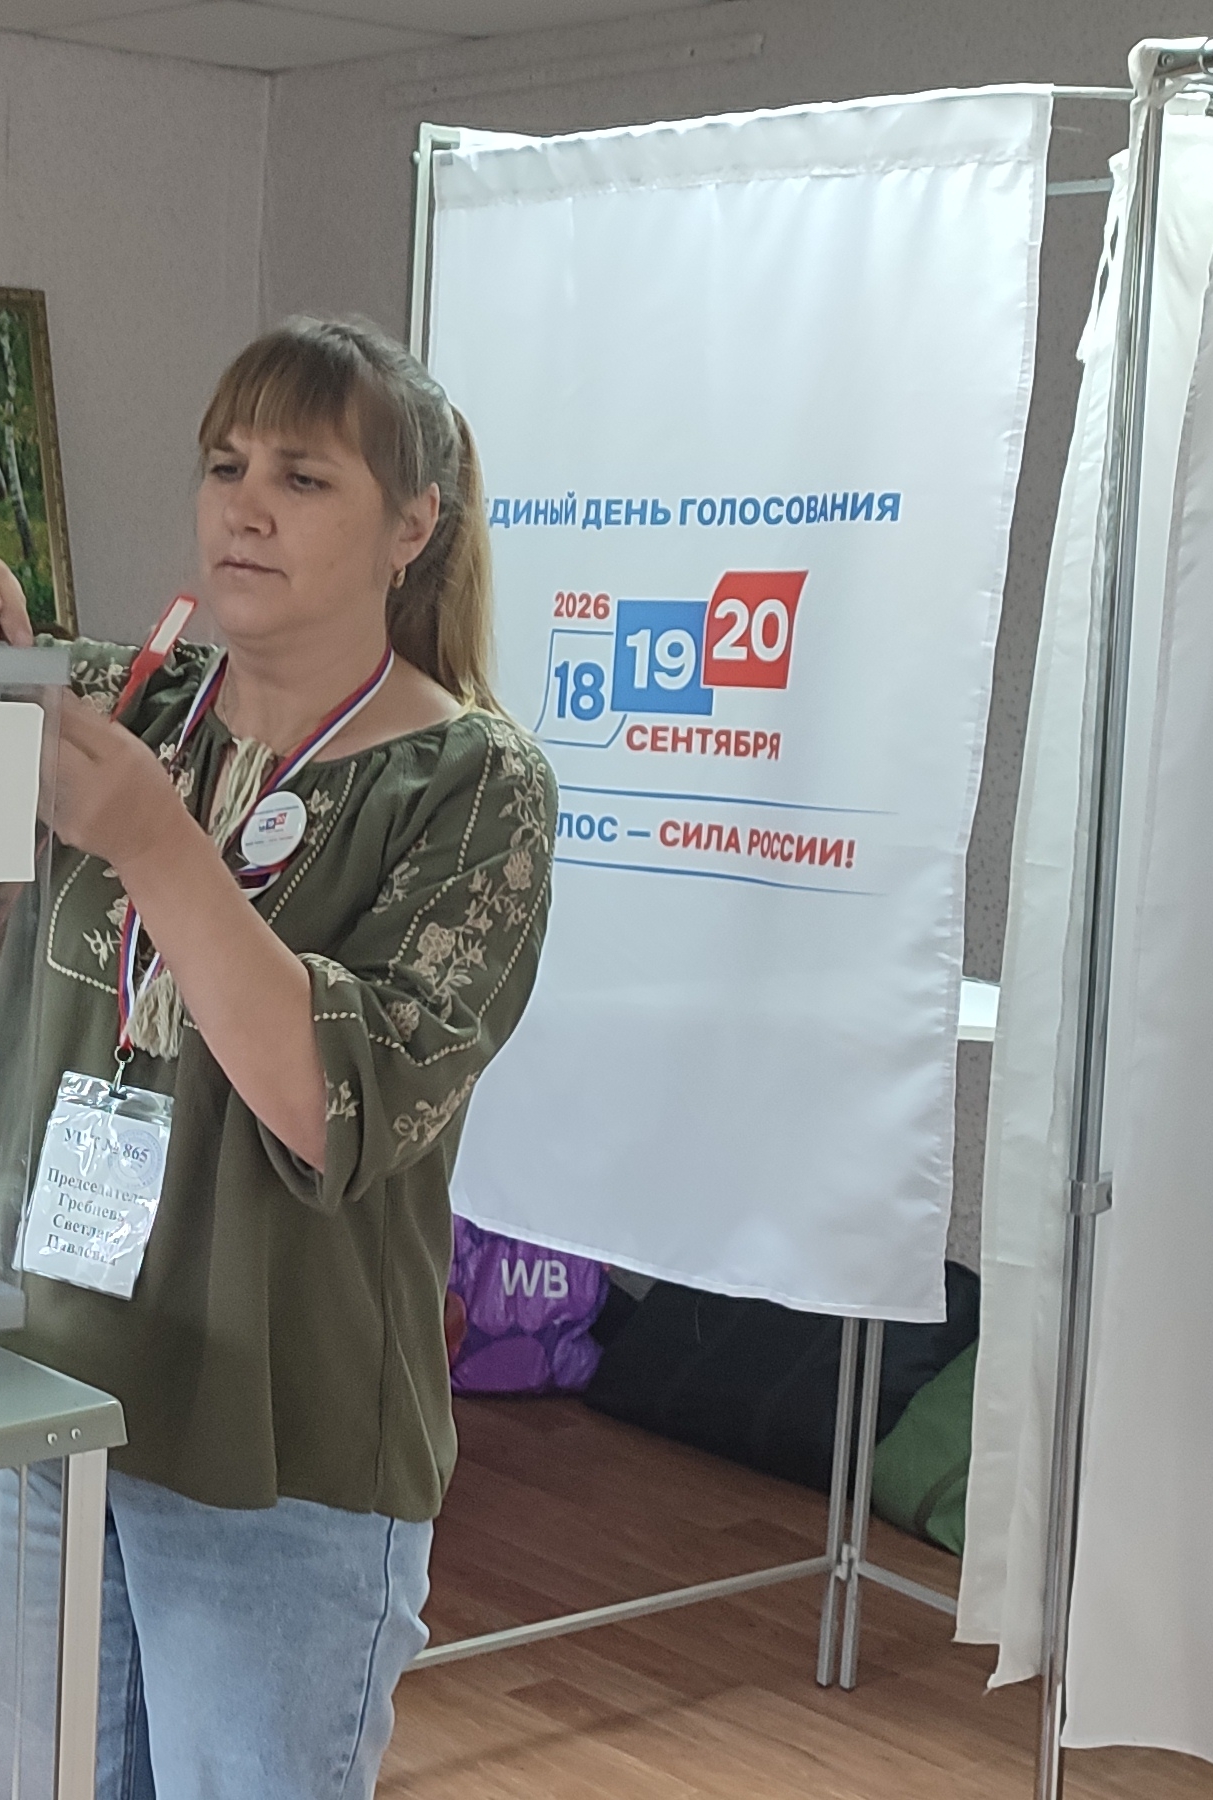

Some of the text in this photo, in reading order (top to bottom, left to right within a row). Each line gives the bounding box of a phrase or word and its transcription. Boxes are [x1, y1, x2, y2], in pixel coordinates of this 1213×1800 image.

[485, 490, 902, 530] ДИНЫЙ ДЕНЬ ГОЛОСОВАНИЯ
[553, 592, 611, 620] 2026
[554, 597, 789, 722] 18 19 20
[625, 724, 782, 761] СЕНТЯБРЯ
[556, 811, 619, 843] ЛОС
[659, 820, 742, 855] СИЛА
[748, 829, 856, 870] РОССИИ!
[122, 1143, 150, 1164] 865
[501, 1258, 569, 1299] WB
